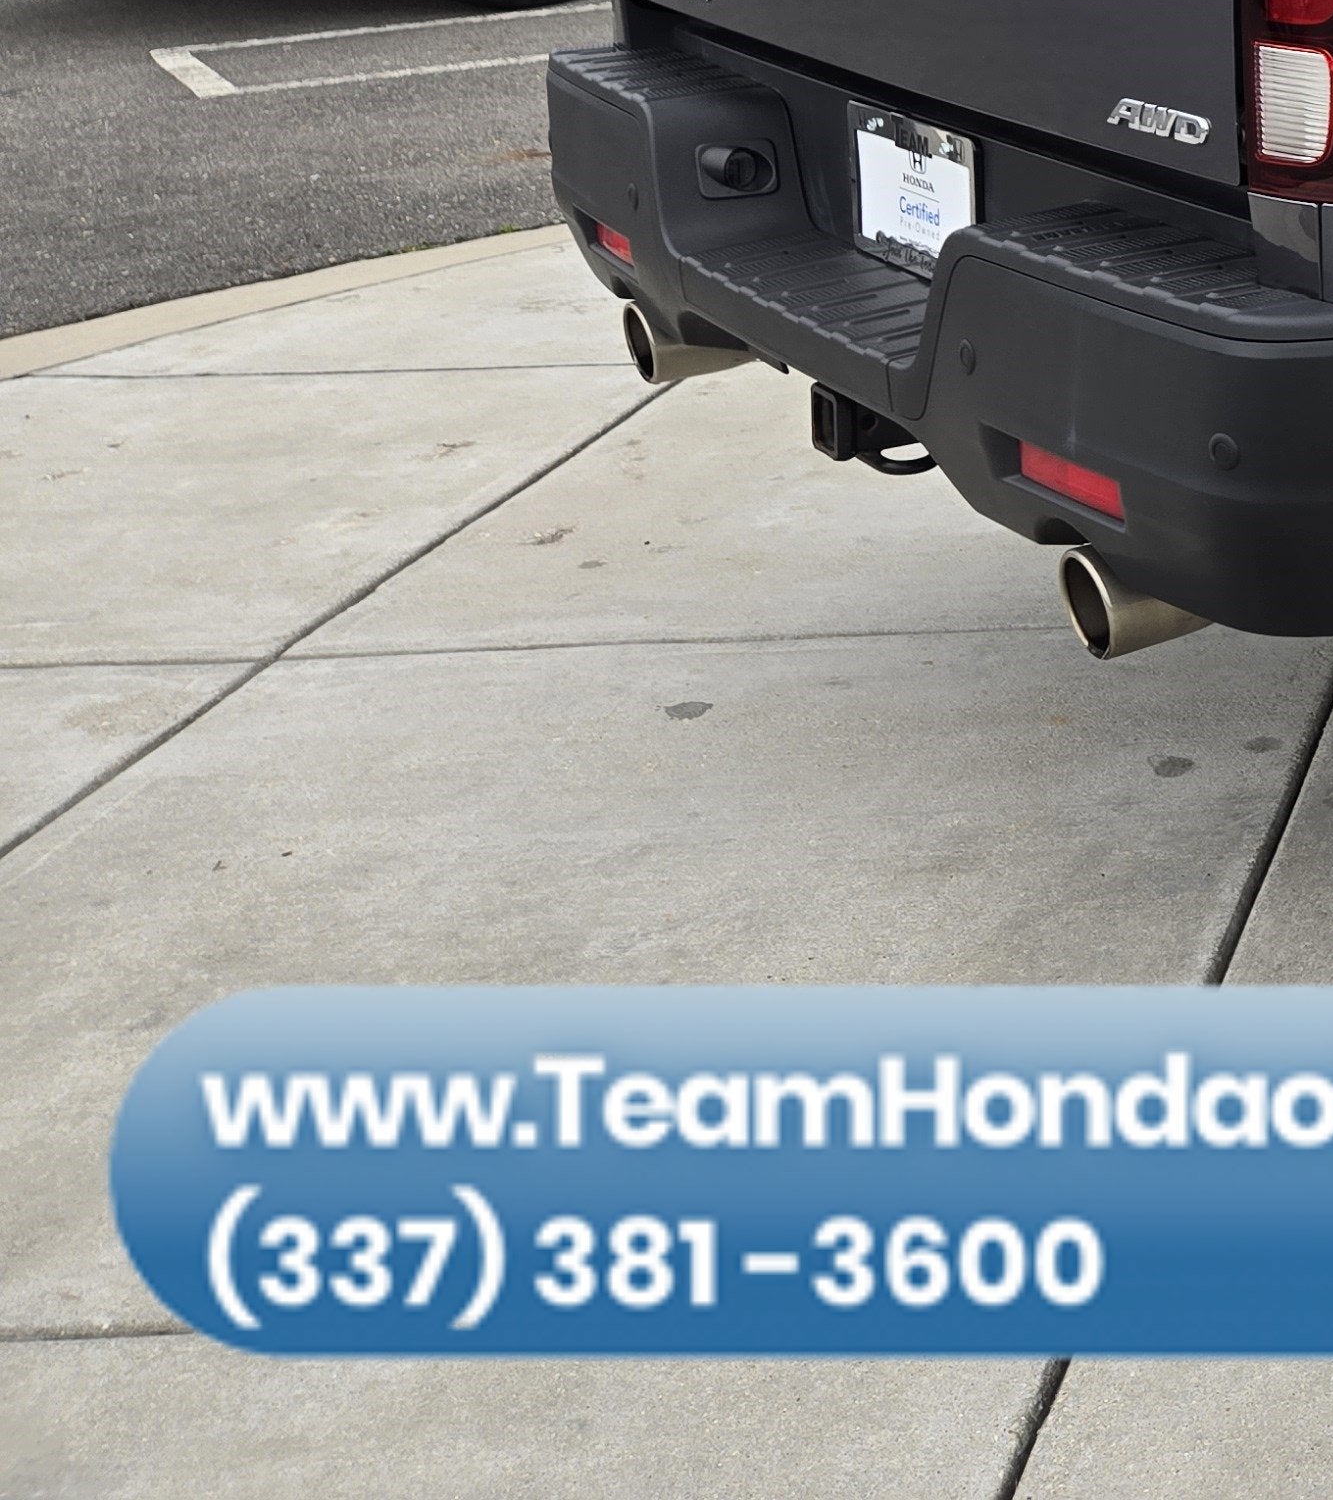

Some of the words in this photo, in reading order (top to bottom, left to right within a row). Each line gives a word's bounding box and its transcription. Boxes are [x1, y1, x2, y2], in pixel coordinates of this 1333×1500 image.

[1106, 97, 1211, 145] AWD
[902, 172, 935, 193] HONDA
[899, 195, 940, 227] Certified
